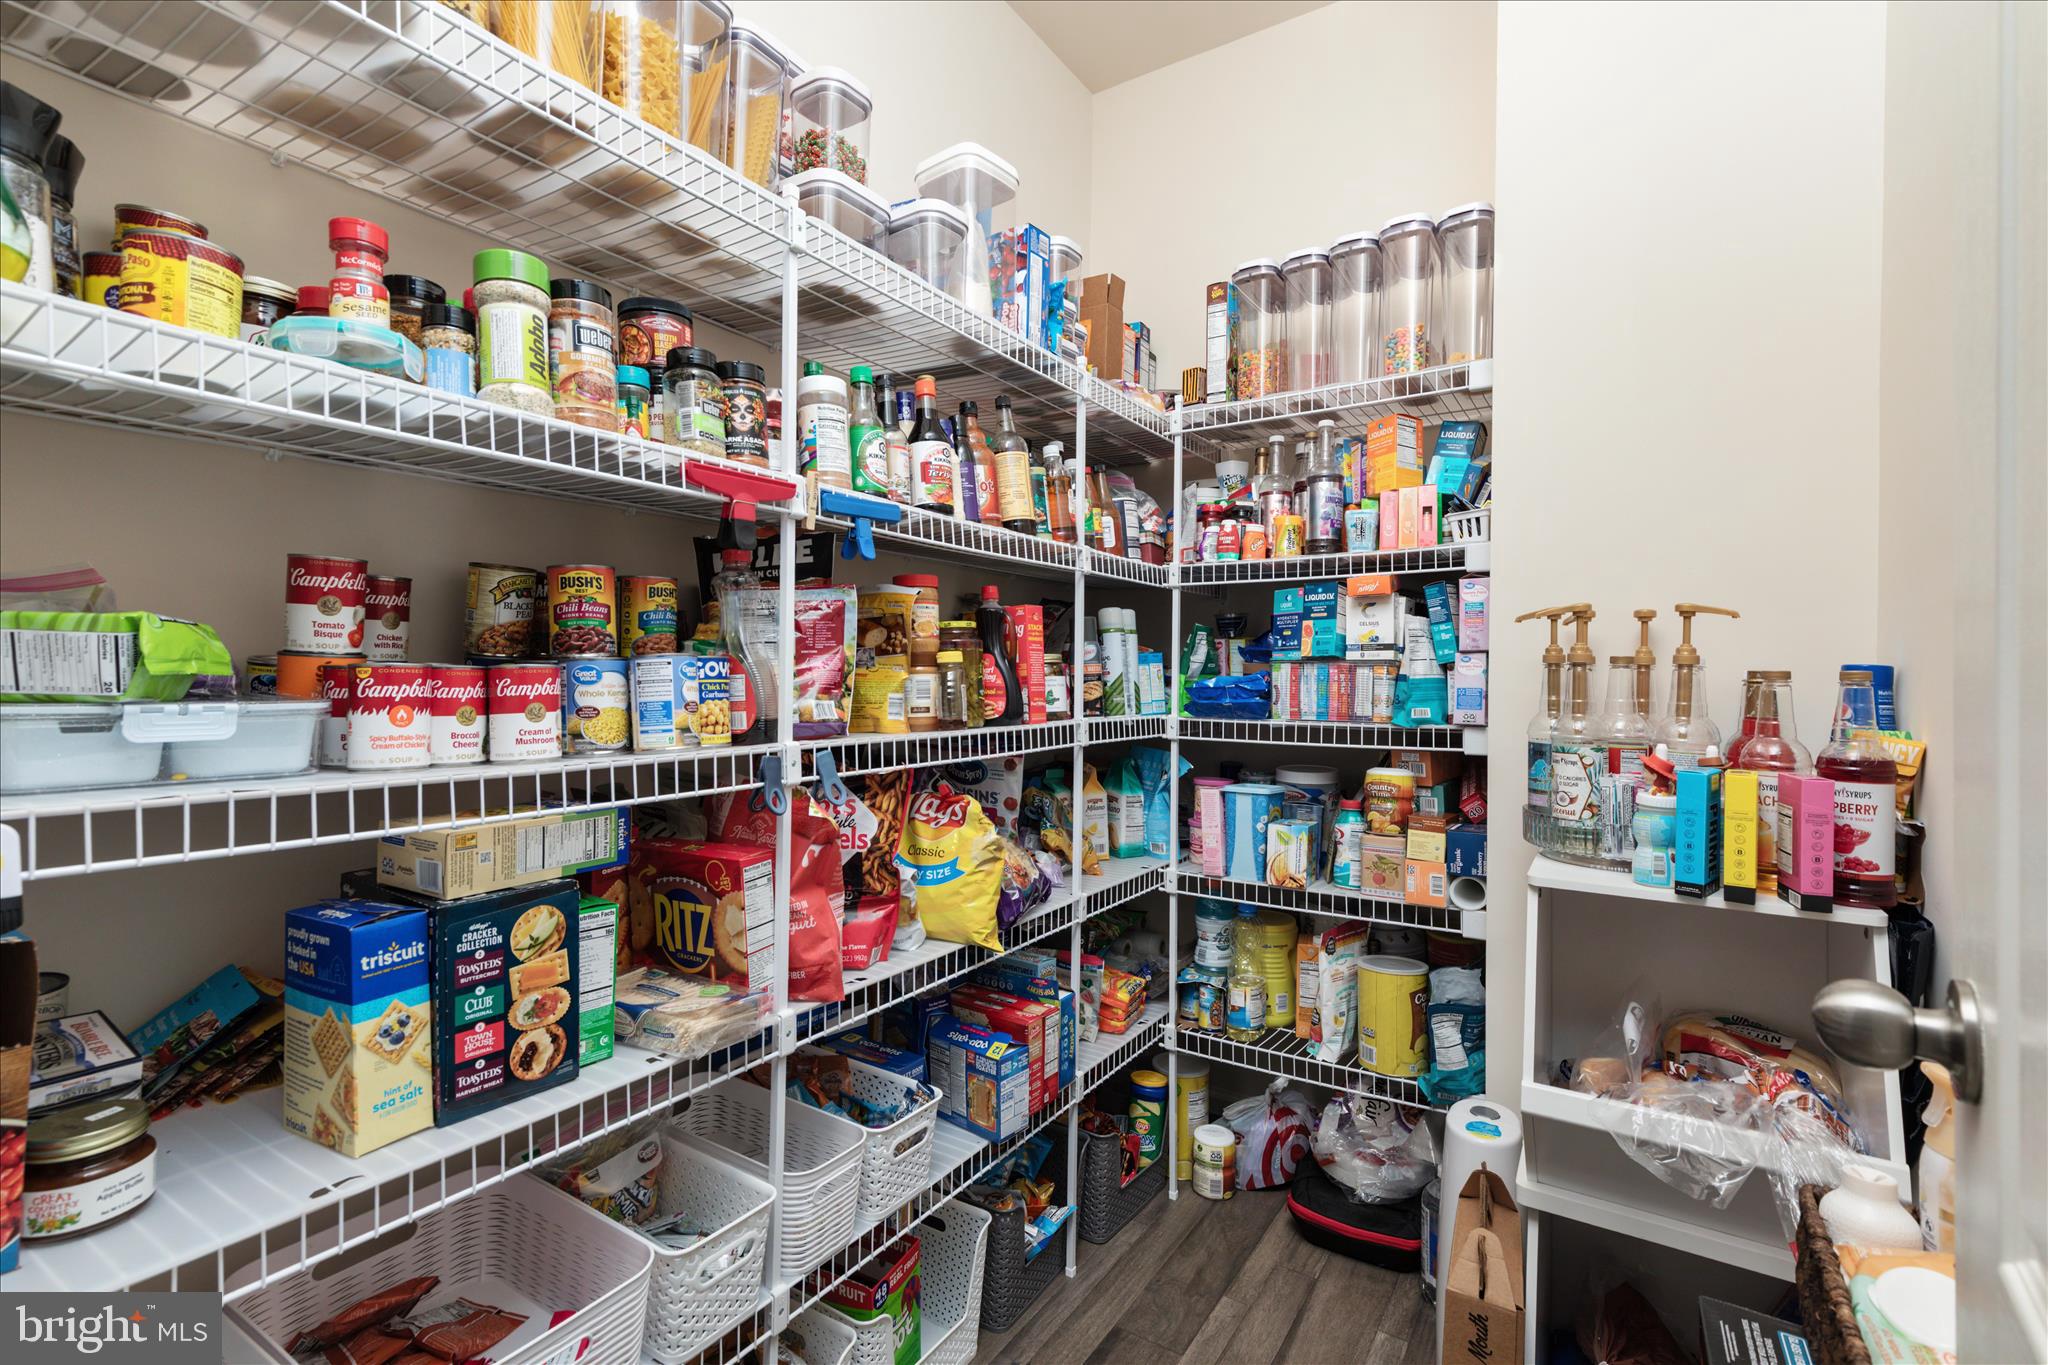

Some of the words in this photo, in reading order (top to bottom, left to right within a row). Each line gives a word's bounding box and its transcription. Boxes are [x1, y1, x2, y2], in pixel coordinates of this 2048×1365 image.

[340, 256, 383, 273] McCormick
[342, 303, 387, 316] Sesame
[355, 311, 379, 319] SEED
[528, 313, 547, 381] Adobo
[559, 575, 604, 591] BUSH'S
[1304, 593, 1326, 602] LIQUID
[556, 602, 581, 615] Chili
[582, 602, 609, 615] Beans
[643, 610, 663, 621] Chili
[312, 620, 346, 631] Tomato
[313, 630, 343, 640] Bisque
[315, 642, 340, 650] SOUP
[374, 641, 391, 650] with
[103, 681, 113, 693] 20
[578, 689, 606, 698] Whole
[701, 683, 720, 691] Chick
[450, 731, 480, 741] Broccoli
[518, 728, 544, 737] Cream
[544, 727, 552, 736] of
[452, 740, 480, 749] Cheese
[515, 736, 555, 746] Mushroom
[455, 752, 477, 761] SOUP
[525, 749, 549, 757] SOUP
[388, 756, 413, 765] SOUP
[1367, 783, 1398, 794] Country
[1371, 790, 1392, 798] Time
[1845, 790, 1872, 800] SYRUPS
[1468, 806, 1485, 819] 40
[617, 817, 626, 851] triscuit
[1708, 804, 1719, 880] PRIME
[907, 844, 946, 858] Classic
[925, 865, 952, 881] SIZE
[598, 909, 616, 919] Facts
[653, 892, 716, 958] RITZ
[287, 927, 309, 943] proudly
[309, 933, 331, 947] grown
[462, 926, 498, 944] CRACKER
[292, 942, 310, 958] baked
[456, 935, 503, 953] COLLECTION
[360, 940, 425, 972] triscuit
[676, 952, 703, 963] CRACKERS
[287, 956, 299, 972] the
[299, 959, 315, 977] USA
[456, 956, 503, 976] TOASTEDS
[459, 970, 500, 984] BUTTERCRISP
[464, 996, 494, 1014] CLUB
[464, 1009, 494, 1021] ORIGINAL
[464, 1030, 493, 1045] TOWN
[463, 1037, 495, 1053] HOUSE
[464, 1047, 493, 1059] ORIGINAL
[456, 1065, 504, 1088] TOASTEDS
[384, 1086, 401, 1098] hint
[402, 1080, 413, 1092] of
[455, 1085, 483, 1099] HARVEST
[482, 1078, 504, 1089] WHEAT
[372, 1099, 397, 1113] sea
[398, 1085, 424, 1106] salt
[31, 1191, 73, 1207] GREAT
[97, 1187, 123, 1202] Apple
[28, 1199, 80, 1215] COUNTRY
[874, 1282, 888, 1301] 48
[1466, 1311, 1493, 1365] Mouth
